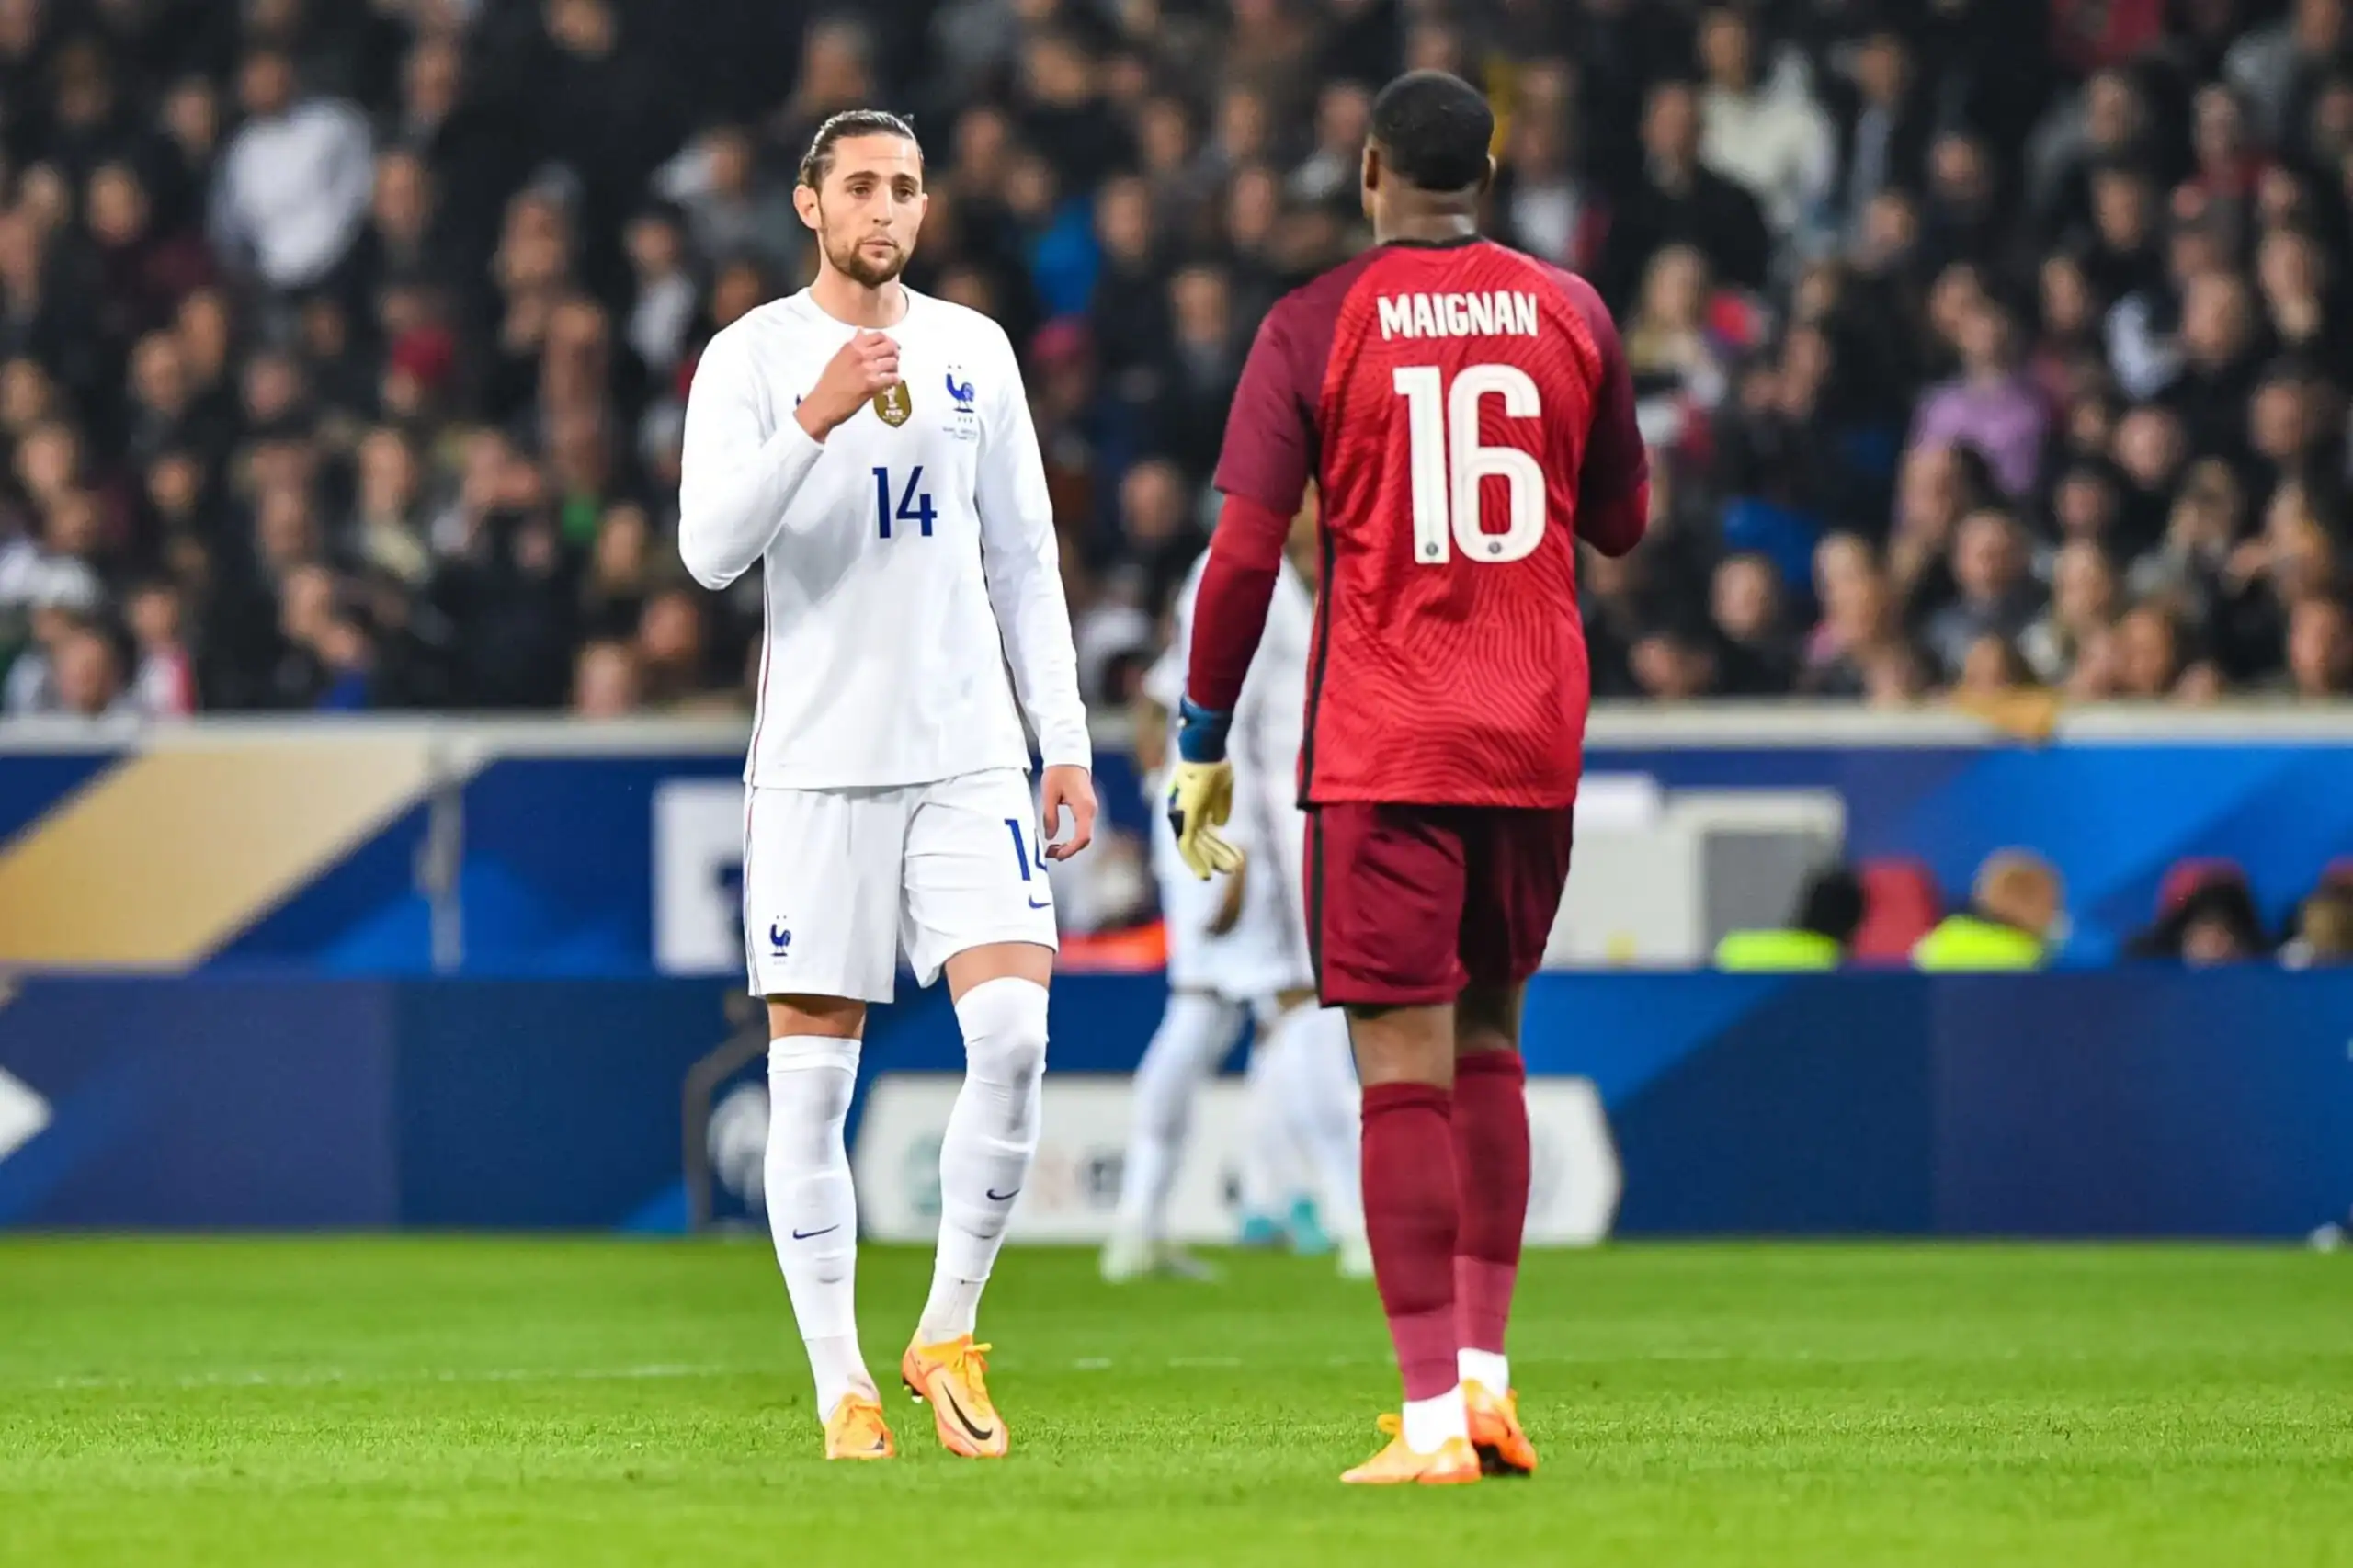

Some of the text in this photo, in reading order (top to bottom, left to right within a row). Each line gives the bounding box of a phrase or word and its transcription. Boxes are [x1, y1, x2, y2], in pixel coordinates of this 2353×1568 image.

[1377, 290, 1539, 341] MAIGNAN
[1392, 363, 1547, 564] 16
[871, 465, 938, 539] 14
